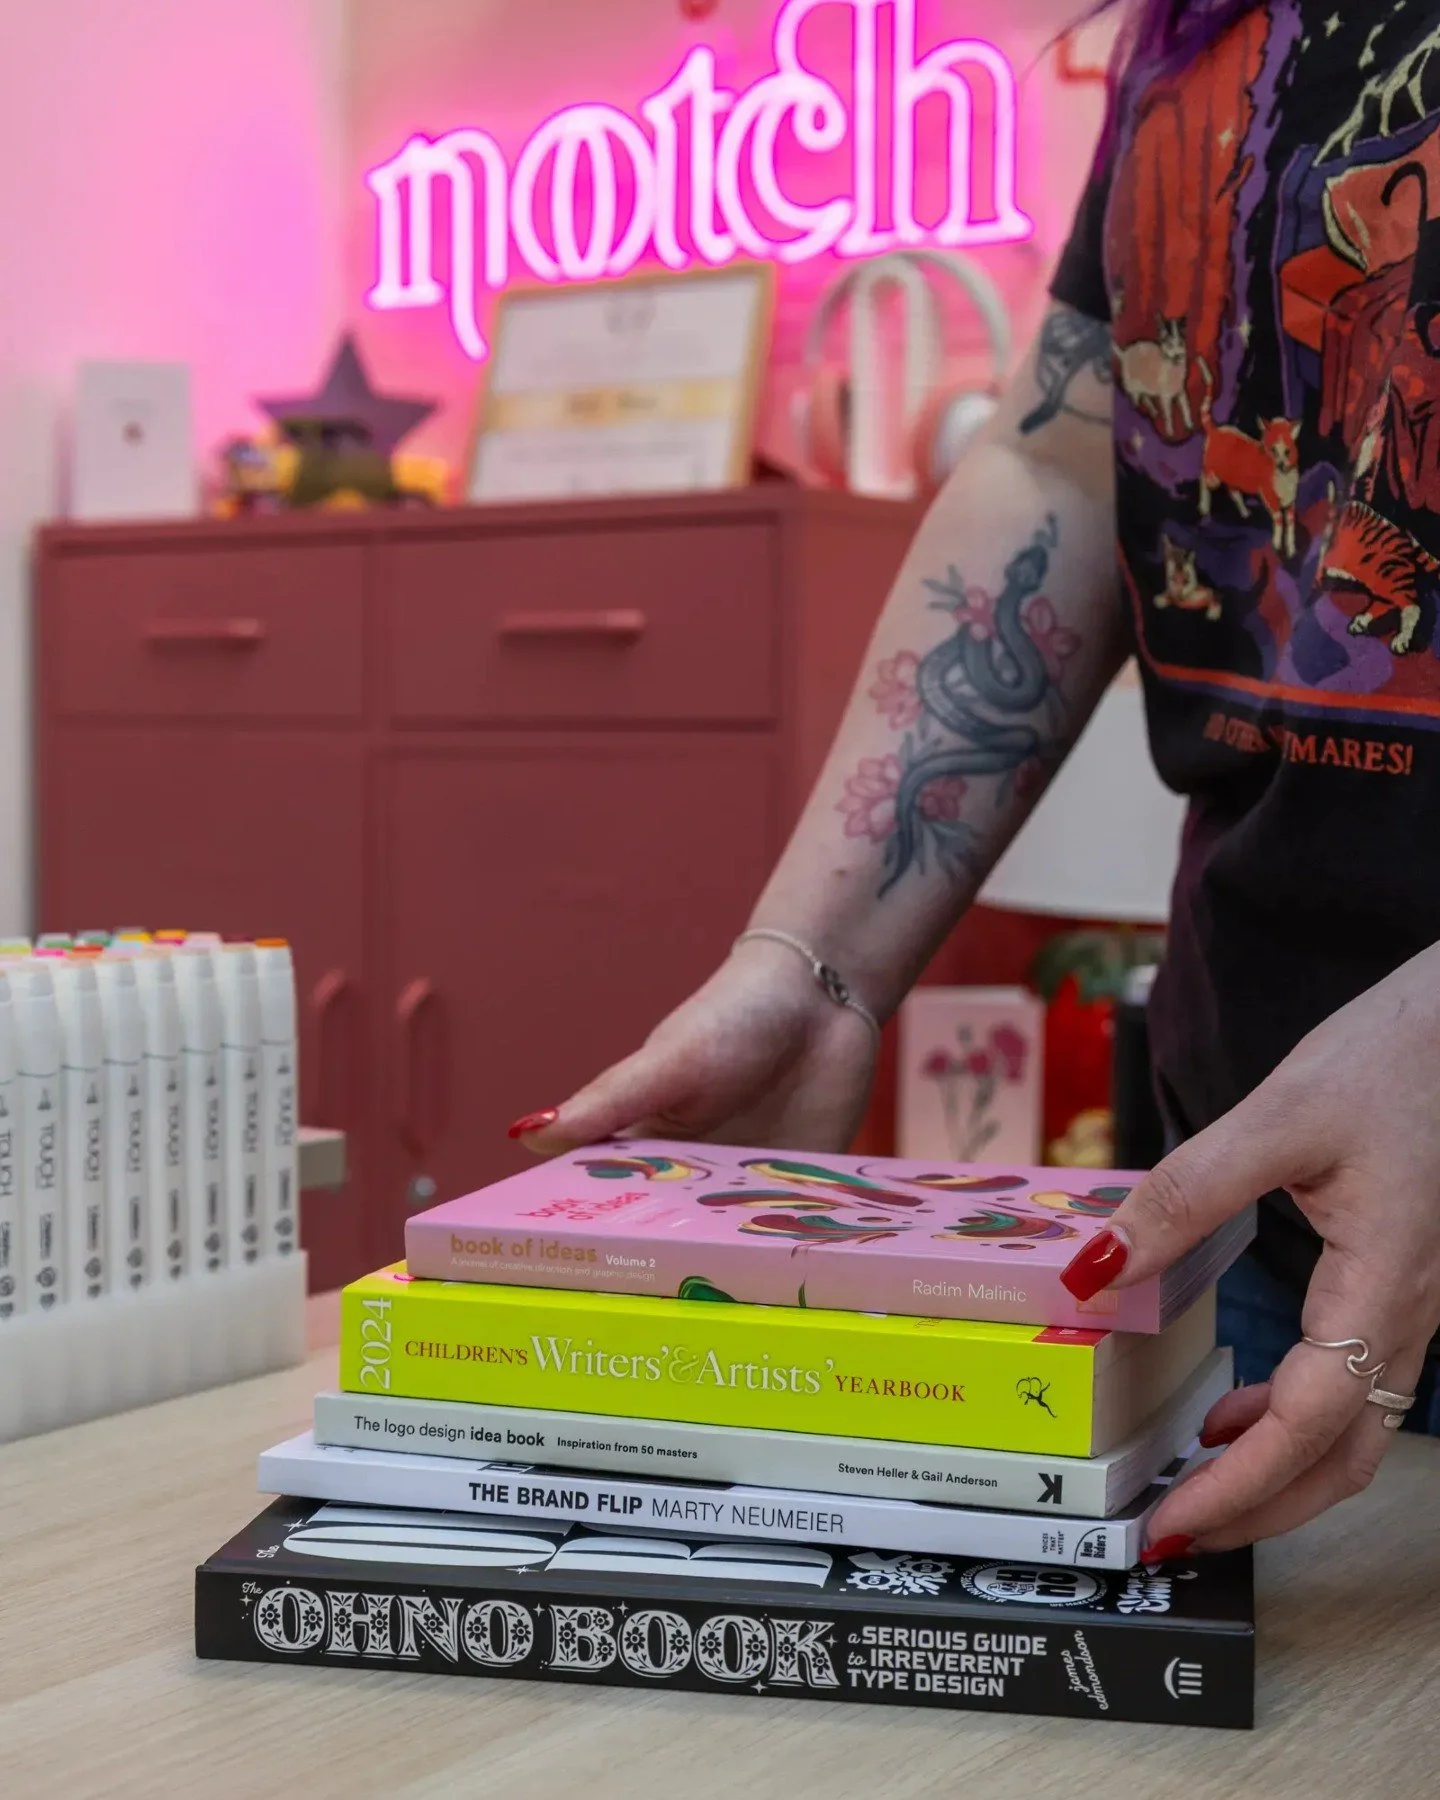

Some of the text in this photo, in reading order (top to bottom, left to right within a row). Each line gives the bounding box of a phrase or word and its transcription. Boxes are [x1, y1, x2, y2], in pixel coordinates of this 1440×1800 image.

[451, 1234, 598, 1262] book of ideas
[605, 1253, 656, 1268] Volume 2
[911, 1279, 1027, 1303] Radim Malinic
[360, 1297, 392, 1390] 2024
[404, 1340, 528, 1365] CHILDREN'S
[834, 1374, 967, 1402] YEARBOOK
[353, 1416, 546, 1447] The logo design idea book
[556, 1436, 698, 1459] Inspiration from 50 masters
[837, 1463, 998, 1488] Steven Heller & Gail Anderson
[468, 1482, 845, 1534] THE BRAND FLIP MARTY NEUMEIER
[241, 1581, 263, 1595] The
[253, 1586, 842, 1688] OHNO BOOK
[847, 1626, 1048, 1656] a SERIOUS GUIDE
[847, 1648, 1025, 1677] to IRREVERENT
[1060, 1649, 1083, 1693] james
[1073, 1630, 1109, 1710] edmondson
[847, 1668, 1005, 1698] TYPE DESIGN
